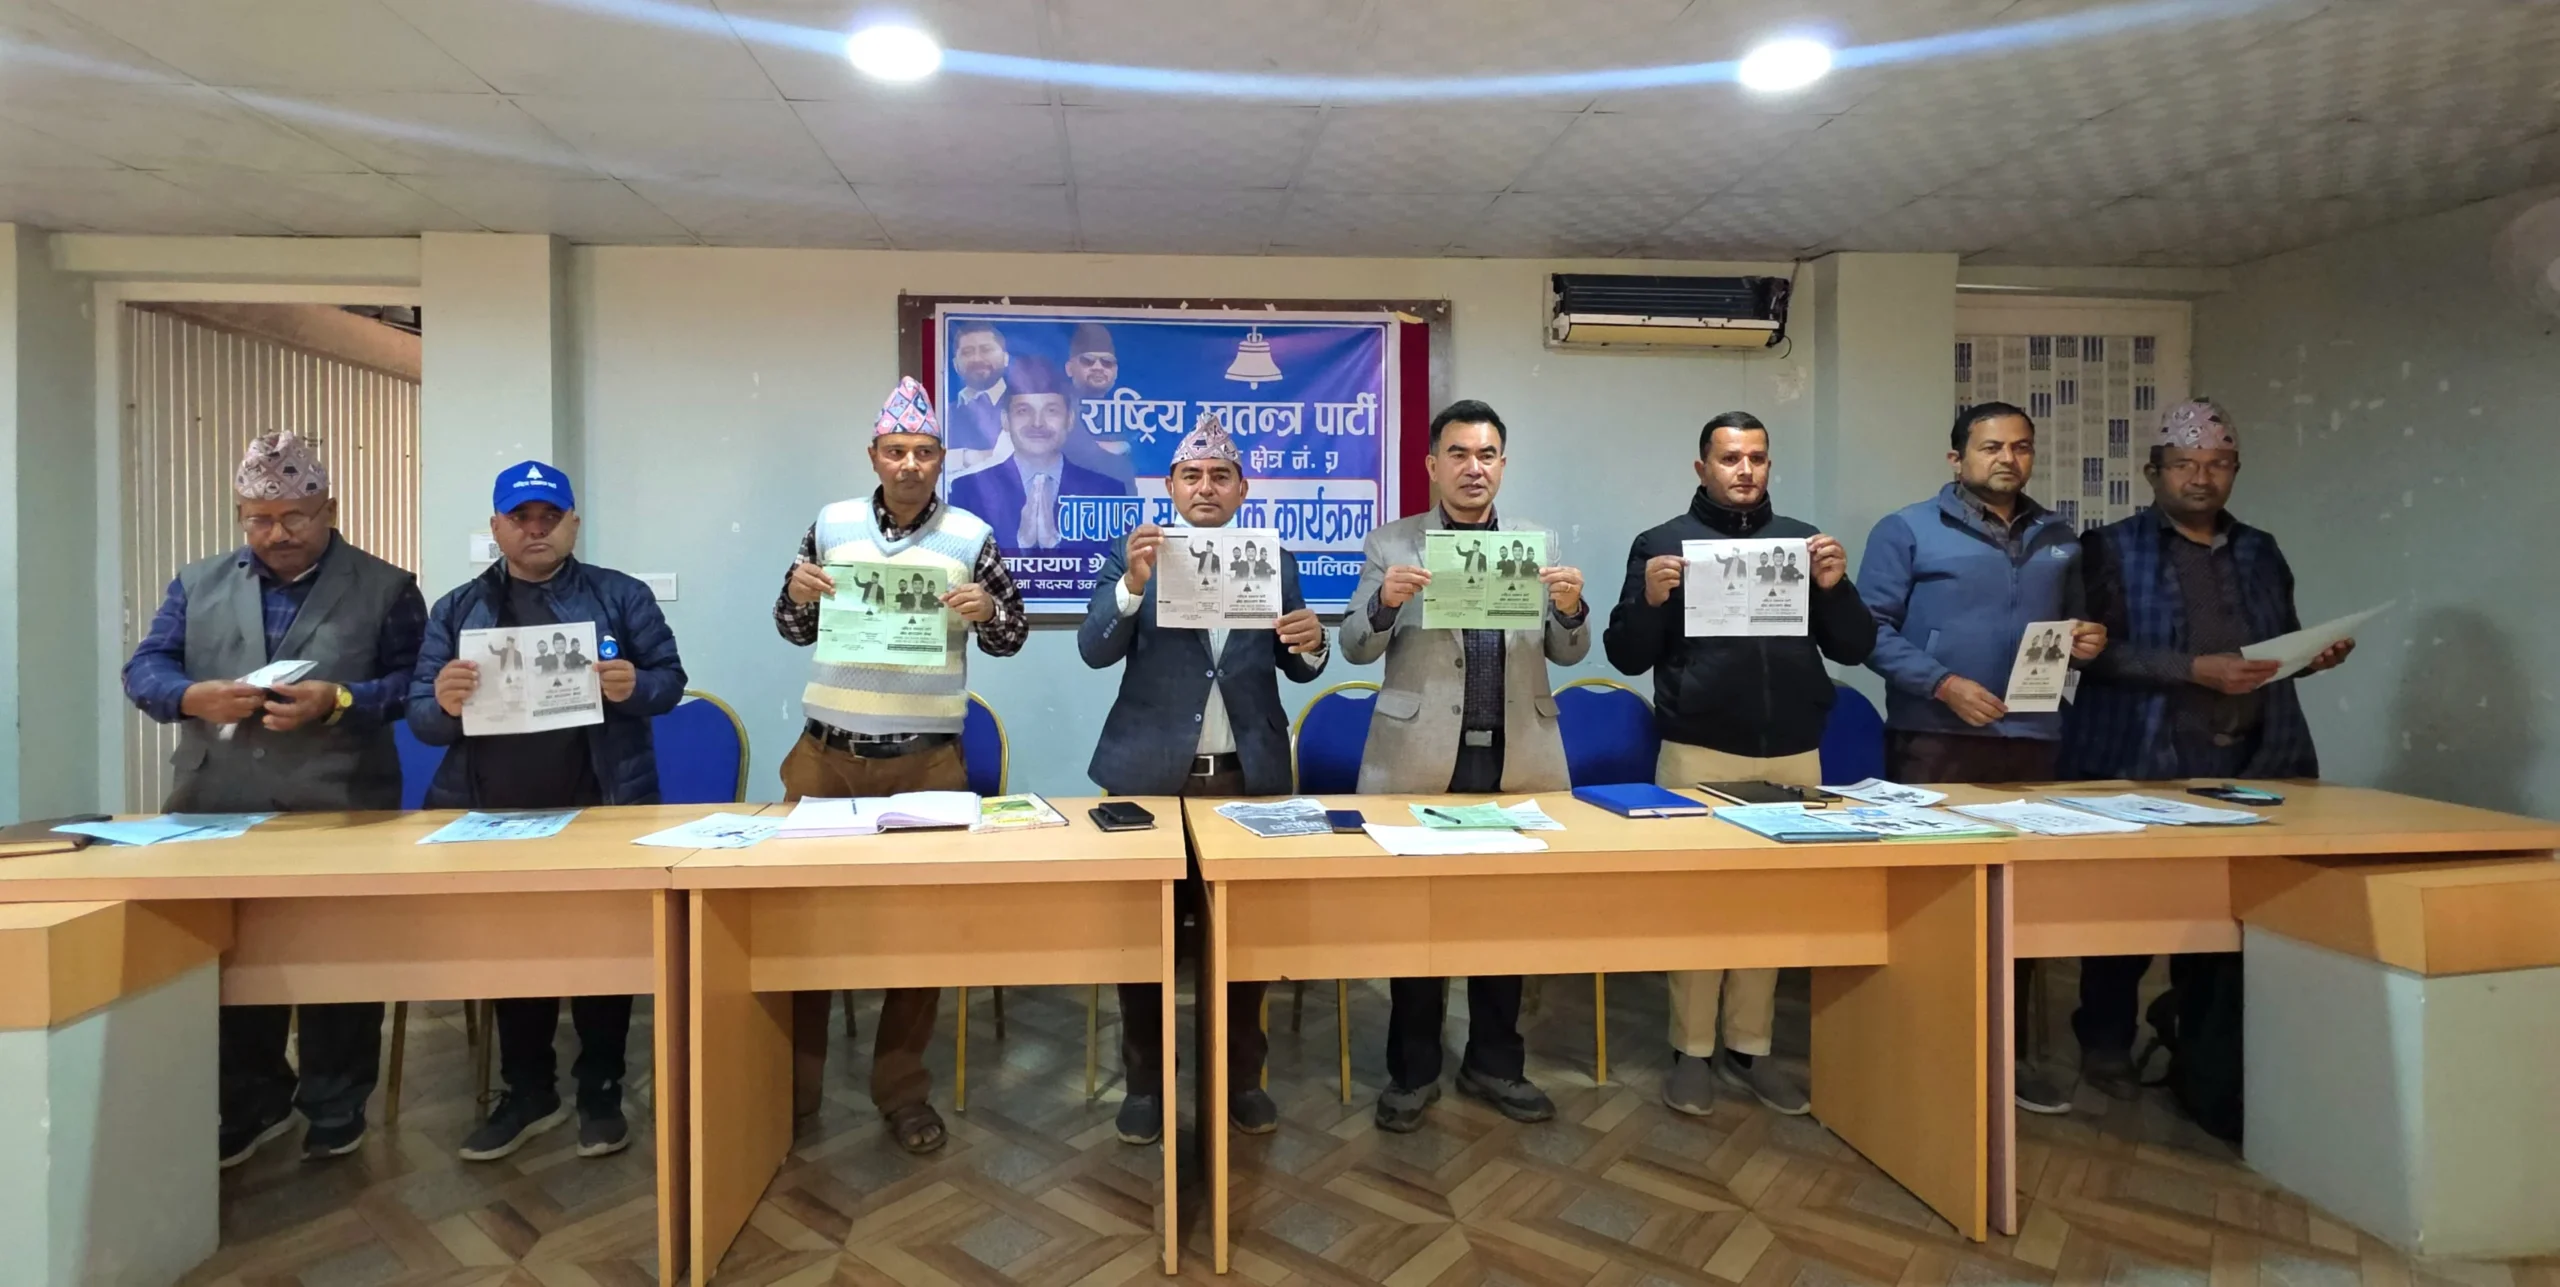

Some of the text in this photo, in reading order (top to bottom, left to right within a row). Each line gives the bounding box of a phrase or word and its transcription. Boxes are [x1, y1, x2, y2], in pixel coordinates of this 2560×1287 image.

[1081, 387, 1186, 443] राष्ट्रिय
[1314, 391, 1378, 436] पार्टी
[1250, 445, 1286, 473] क्षेत्र
[1274, 486, 1375, 544] कार्यक्रम
[1035, 579, 1074, 590] सदस्य
